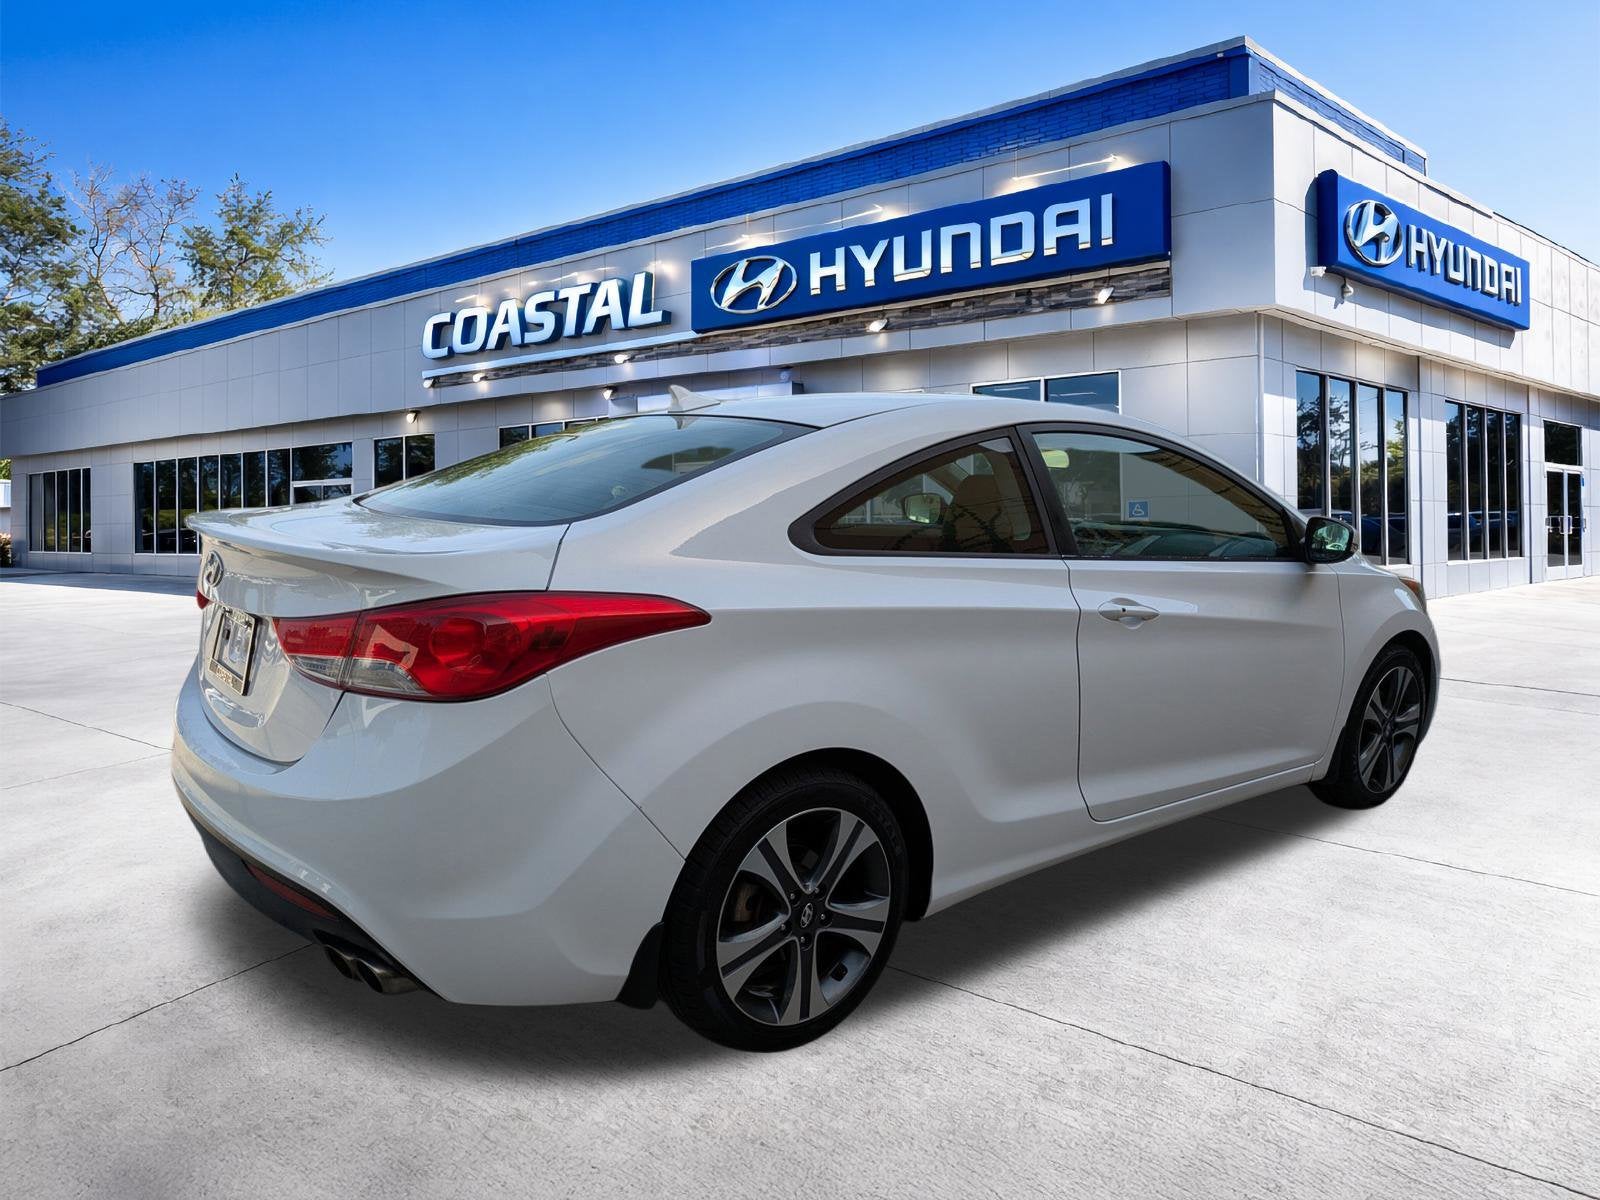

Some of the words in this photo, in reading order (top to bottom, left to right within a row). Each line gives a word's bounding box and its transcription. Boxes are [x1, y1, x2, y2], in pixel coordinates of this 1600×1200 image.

[809, 193, 1114, 296] HYUNDAI
[1406, 224, 1522, 306] HYUNDAI
[422, 271, 669, 360] COASTAL
